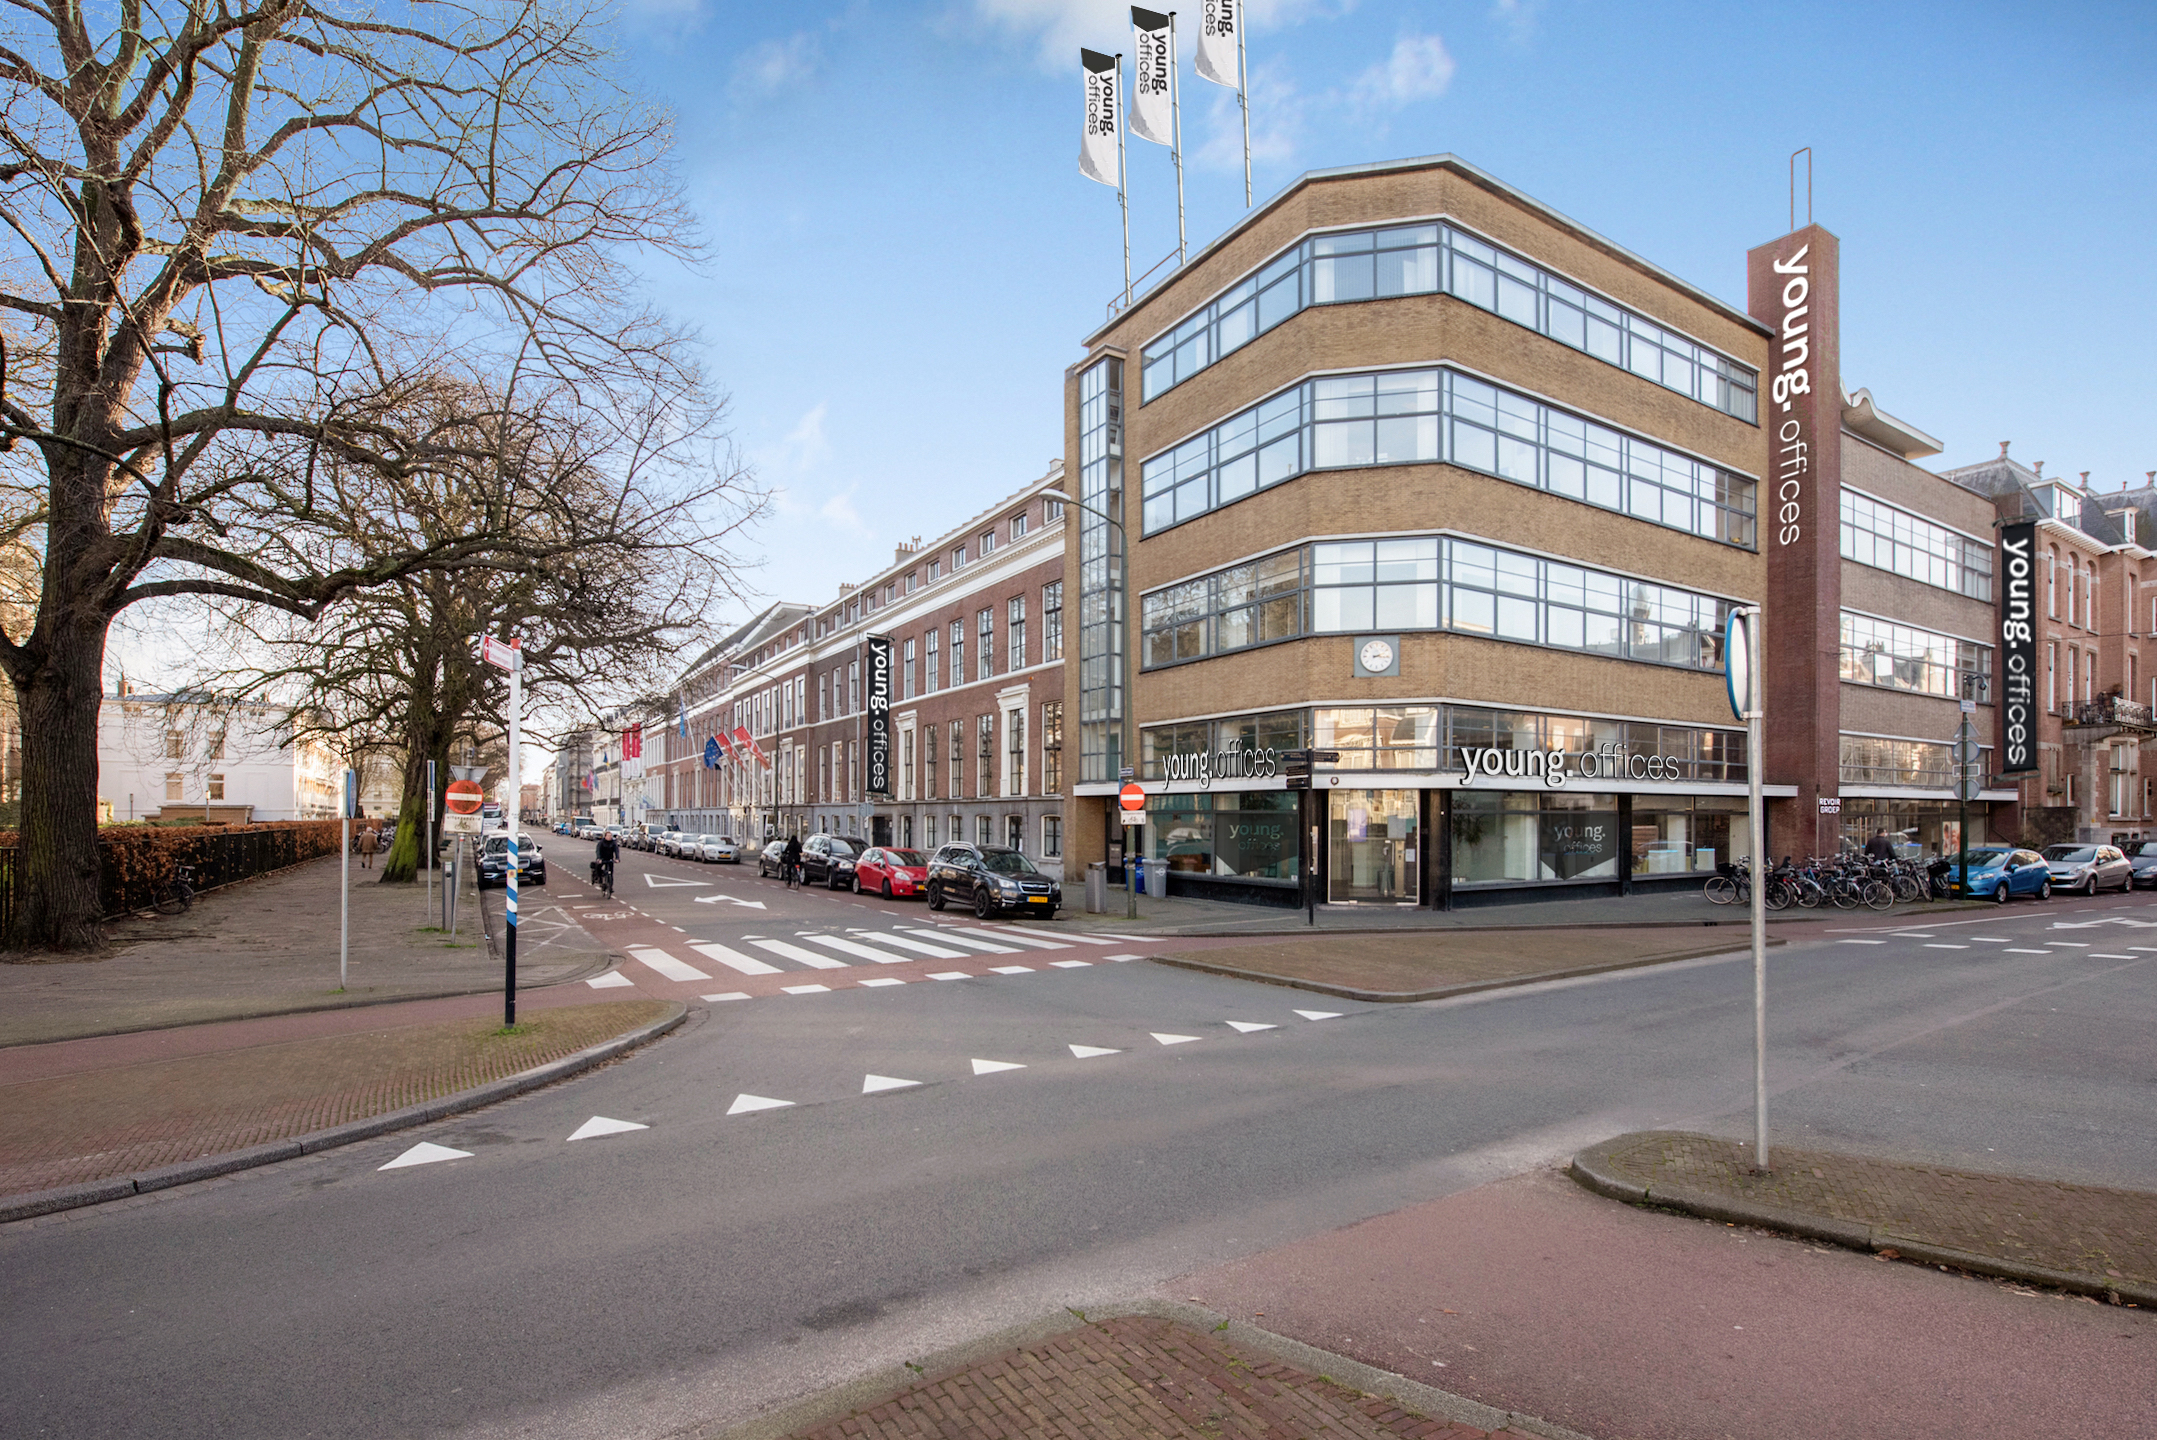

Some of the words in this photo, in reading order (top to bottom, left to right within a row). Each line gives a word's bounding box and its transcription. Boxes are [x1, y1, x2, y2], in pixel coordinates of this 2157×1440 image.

[1139, 33, 1152, 95] offices
[1152, 33, 1168, 96] young.
[1088, 75, 1100, 136] offices
[1099, 75, 1115, 137] young.
[1773, 244, 1811, 413] young.
[1779, 419, 1808, 547] offices
[2003, 538, 2031, 649] young.
[870, 642, 889, 716] young.
[2007, 653, 2032, 766] offices
[872, 718, 888, 789] offices
[1162, 748, 1214, 790] young.
[1215, 738, 1277, 780] offices
[1459, 745, 1574, 788] young.
[1579, 742, 1681, 781] offices
[1229, 824, 1285, 840] young.
[1819, 798, 1841, 806] REVOIR
[1820, 806, 1840, 814] GROEP
[1554, 825, 1607, 842] young.
[1563, 841, 1603, 853] offices
